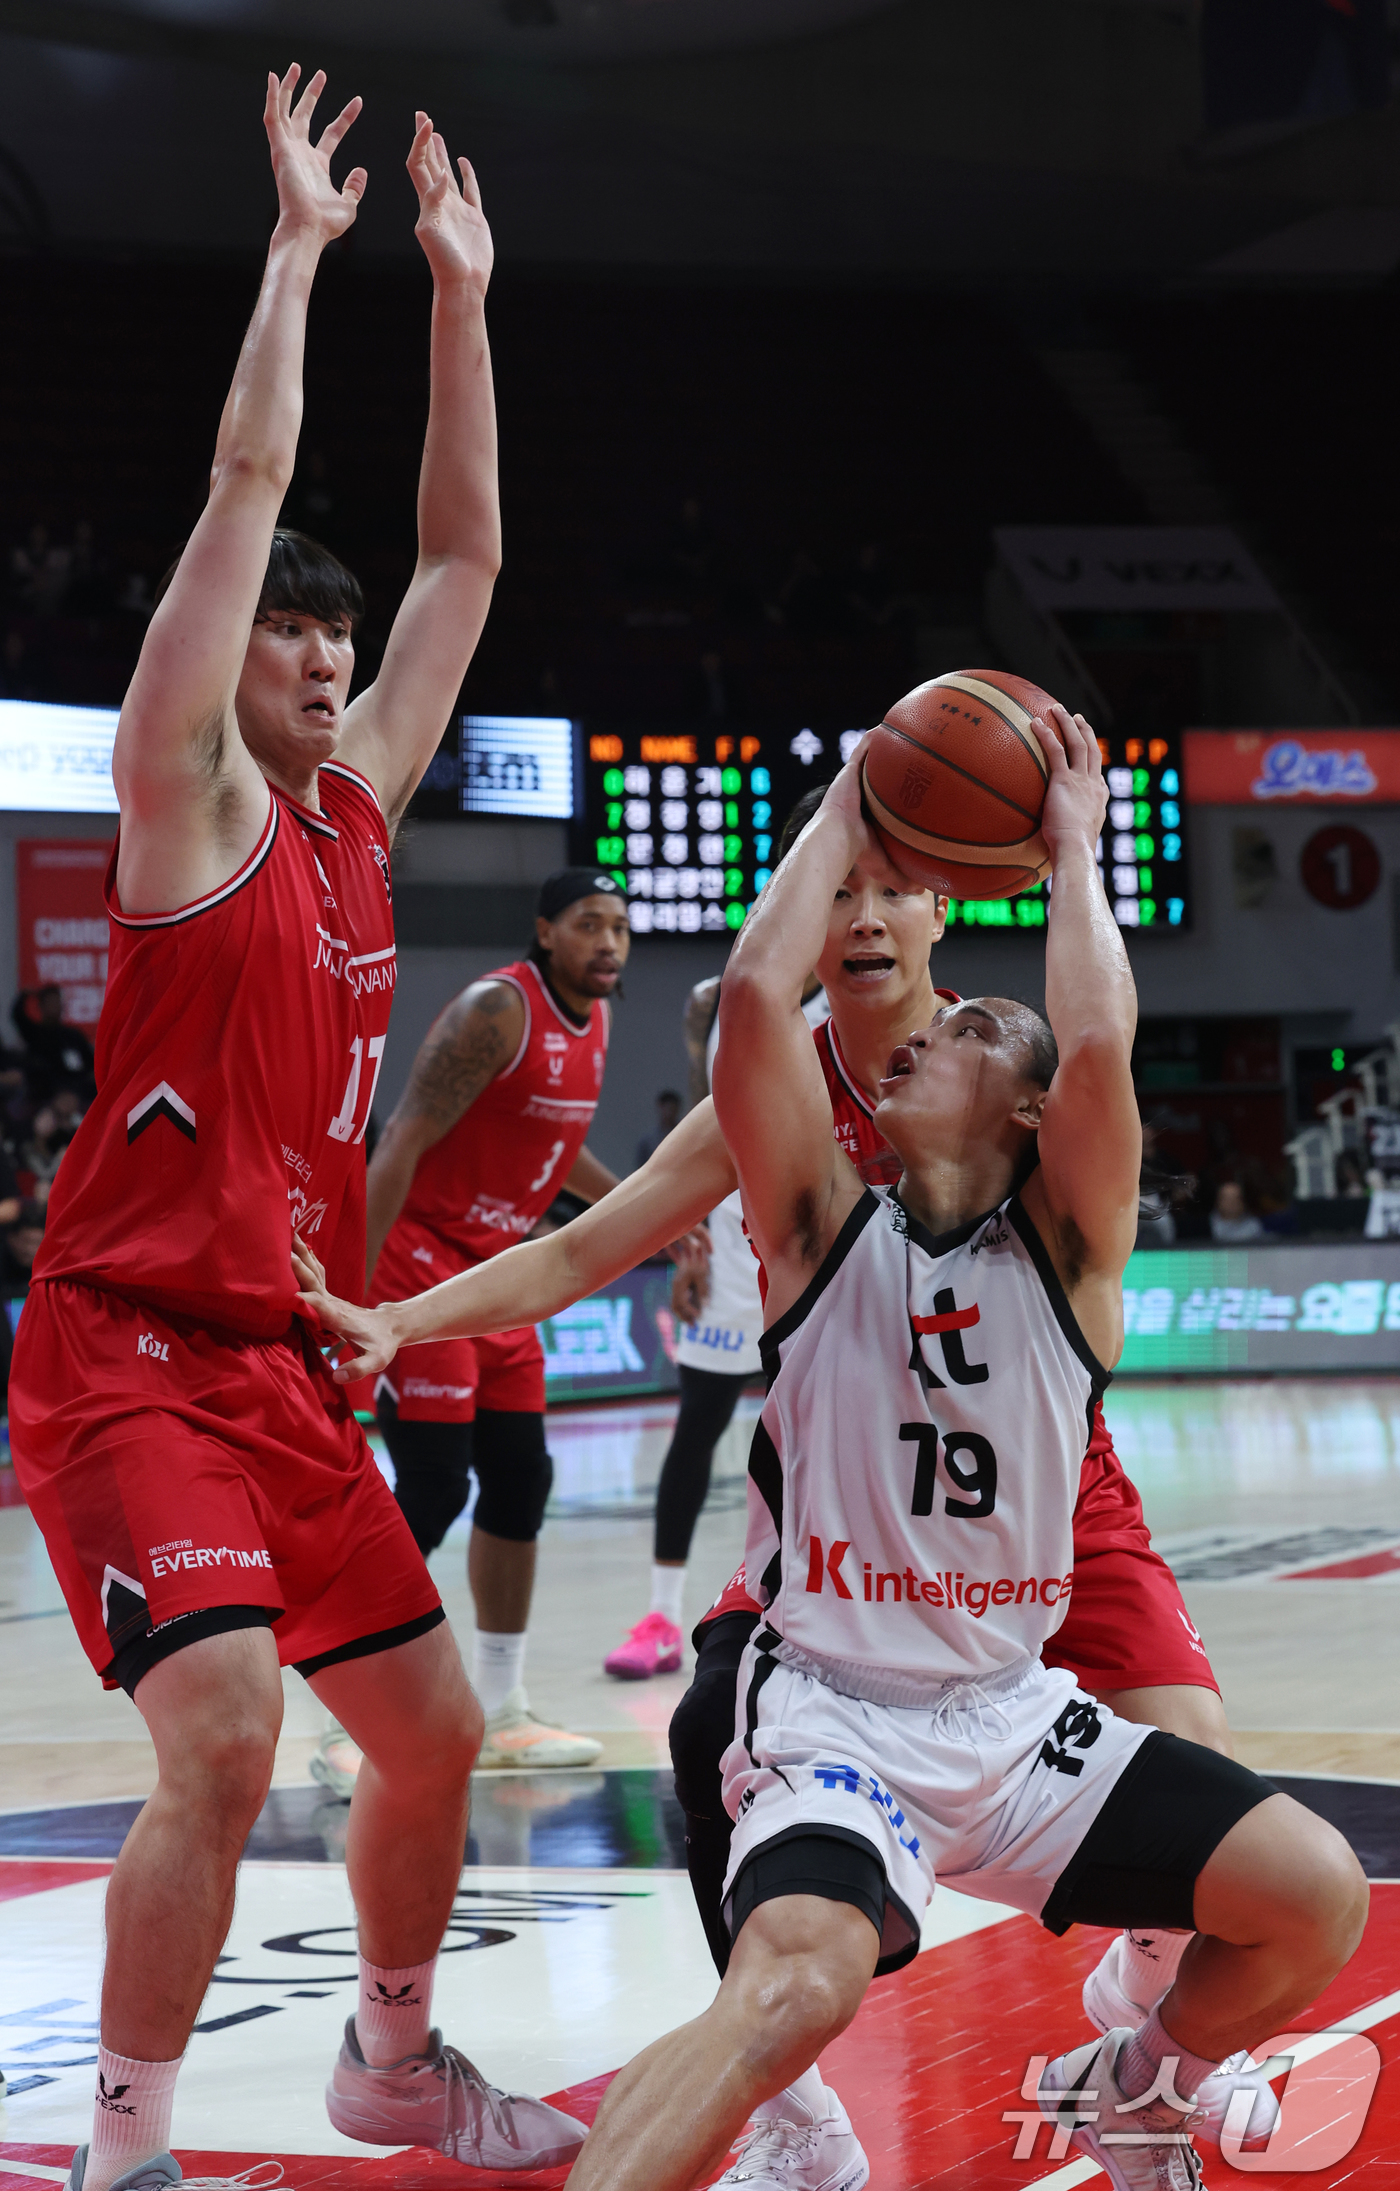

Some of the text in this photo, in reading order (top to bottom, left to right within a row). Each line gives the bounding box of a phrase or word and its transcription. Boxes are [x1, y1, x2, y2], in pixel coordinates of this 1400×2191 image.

[640, 735, 698, 763] NAME
[715, 735, 734, 763] F
[740, 736, 761, 763] P
[1125, 738, 1144, 765] F
[1148, 738, 1168, 765] P
[1132, 768, 1150, 796] 2
[1159, 768, 1180, 796] 4
[604, 802, 623, 830] 7
[725, 801, 739, 829] 1
[752, 801, 772, 829] 2
[1133, 801, 1152, 829] 2
[595, 836, 625, 865] 12
[723, 835, 743, 863] 2
[752, 834, 773, 863] 7
[1162, 833, 1182, 861] 2
[724, 868, 743, 896] 2
[1138, 866, 1153, 893] 1
[1325, 843, 1351, 894] 1
[1138, 897, 1156, 926] 2
[1166, 897, 1185, 926] 7
[326, 1033, 387, 1144] 17
[530, 1140, 565, 1192] 3
[137, 1332, 170, 1362] KBL
[898, 1421, 998, 1518] 19
[148, 1538, 193, 1557] 에브리타임
[805, 1535, 1075, 1619] K intelligence
